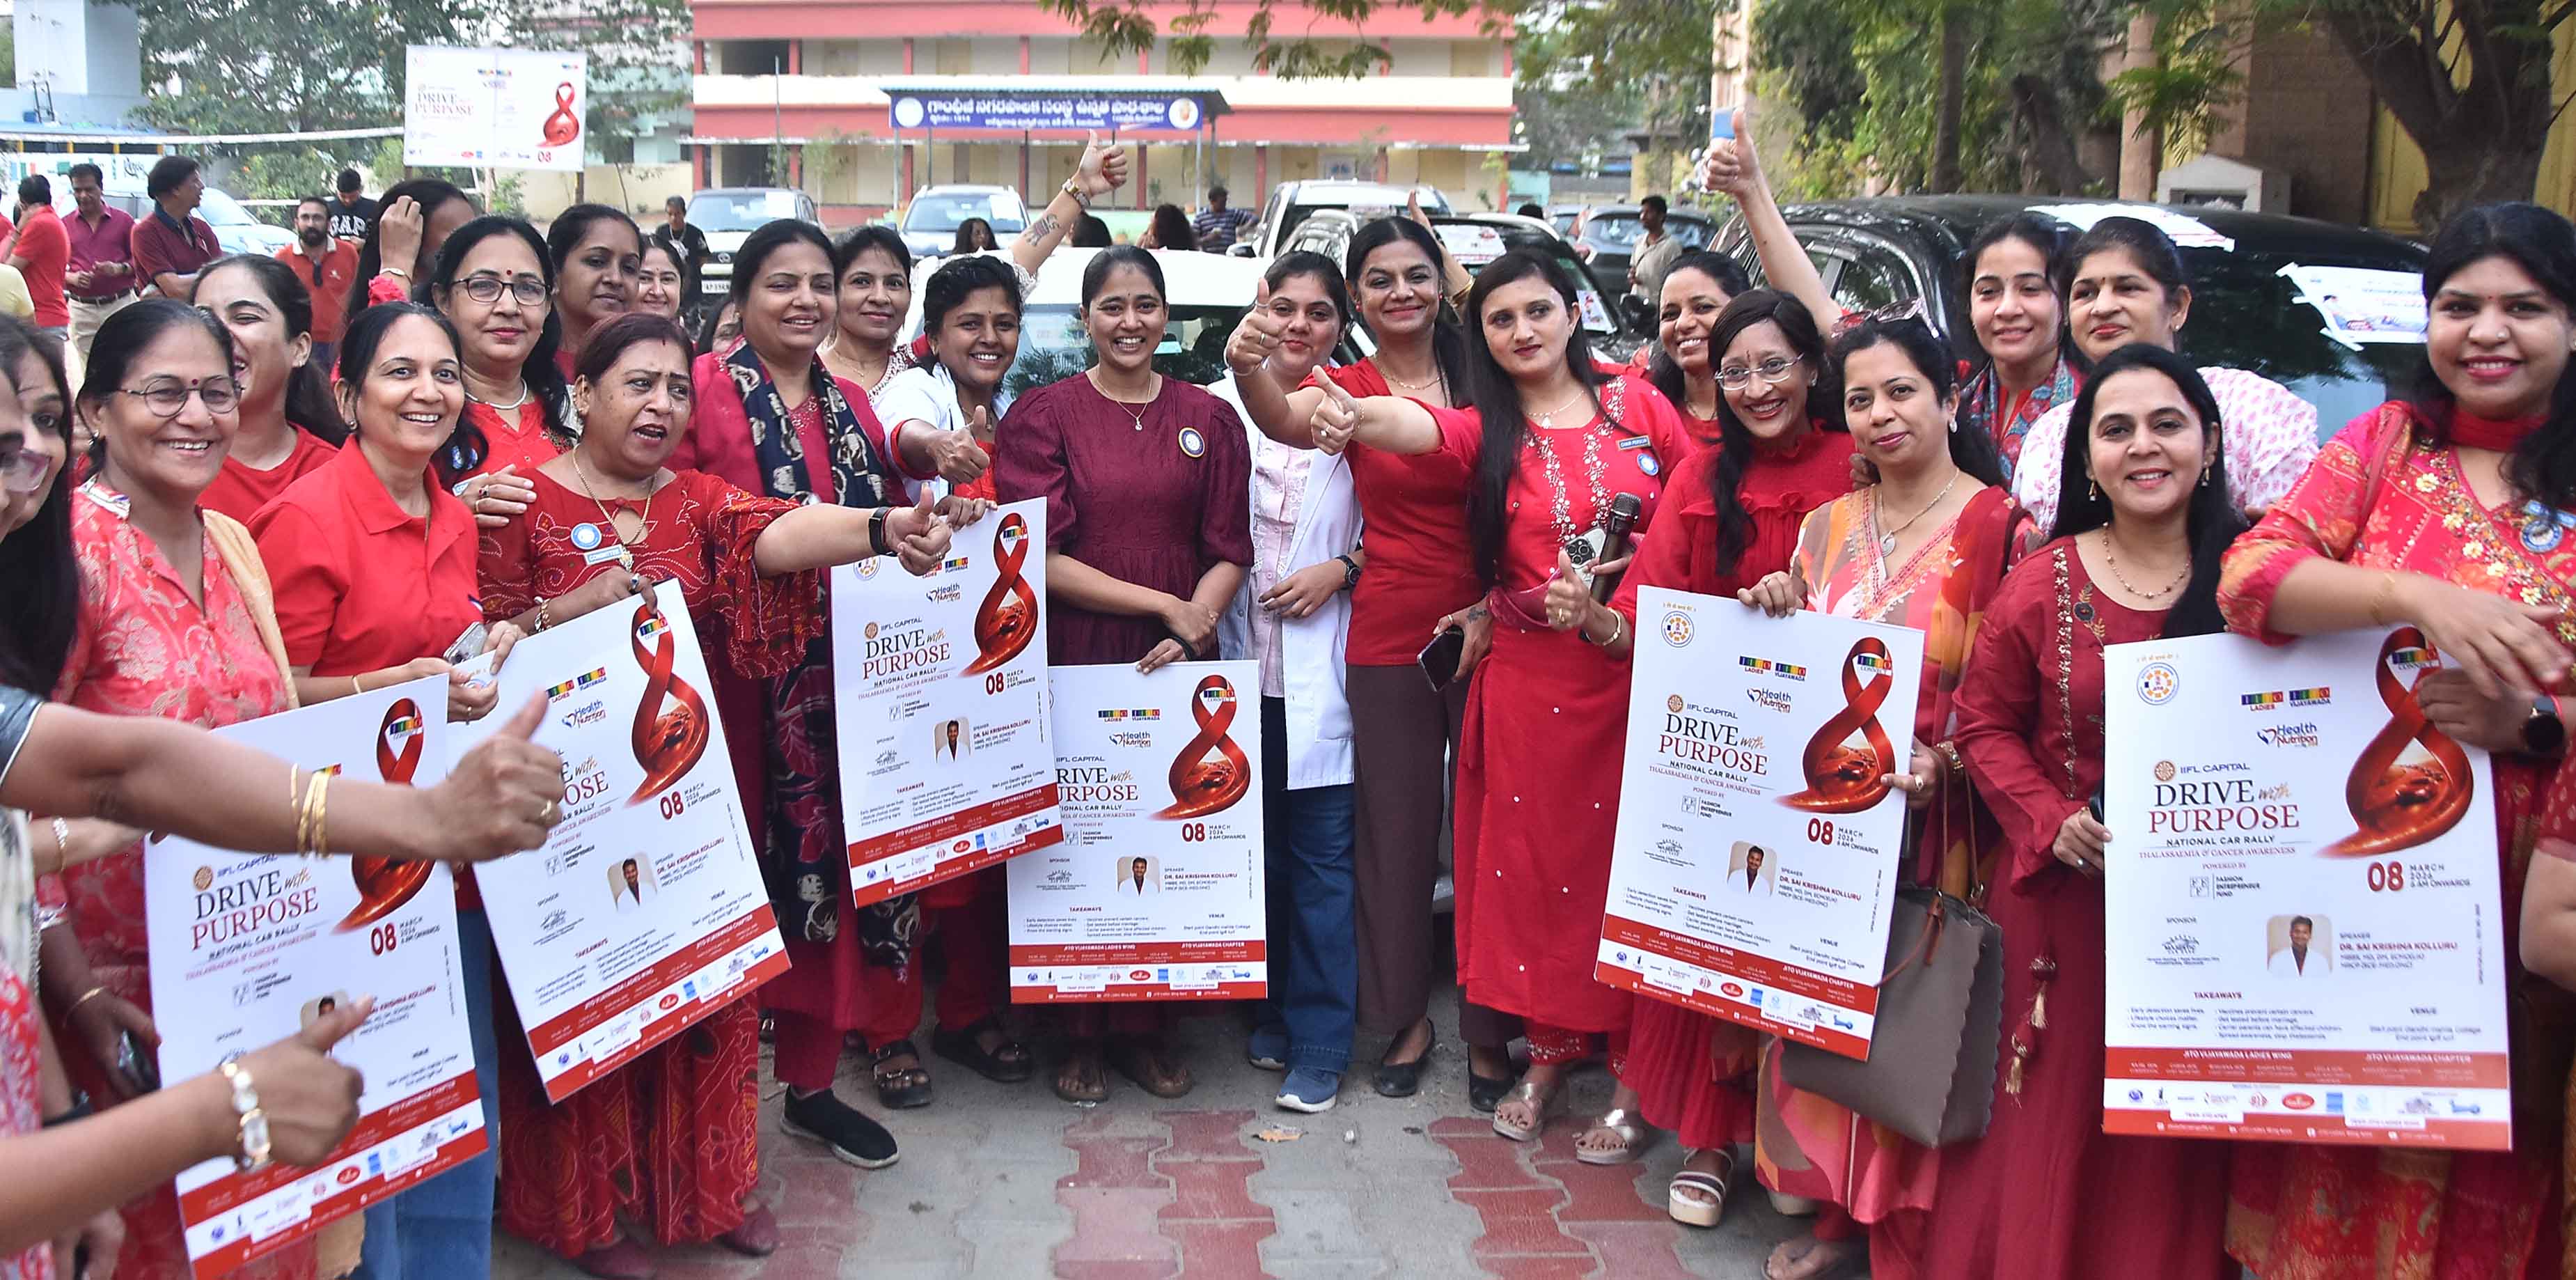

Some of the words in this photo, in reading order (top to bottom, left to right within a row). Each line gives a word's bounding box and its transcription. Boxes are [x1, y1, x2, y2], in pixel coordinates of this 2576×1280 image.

[937, 582, 960, 593] Health
[865, 629, 925, 659] DRIVE
[927, 627, 945, 643] with
[863, 643, 950, 680] PURPOSE
[874, 676, 904, 689] NATIONAL
[905, 671, 918, 680] CAR
[919, 667, 937, 677] RALLY
[1744, 666, 1764, 676] LADIES
[985, 671, 1004, 695] 08
[1007, 669, 1023, 678] MARCH
[1761, 687, 1791, 703] Health
[574, 699, 603, 715] Health
[1687, 703, 1702, 712] IIFL
[1703, 706, 1738, 719] CAPITAL
[1760, 697, 1791, 713] Nutrition
[1123, 731, 1151, 740] Health
[1665, 712, 1739, 747] DRIVE
[1741, 735, 1766, 749] with
[2277, 722, 2317, 737] Health
[2277, 733, 2318, 747] Nutrition
[1658, 734, 1768, 776] PURPOSE
[574, 756, 597, 776] with
[1670, 760, 1706, 774] NATIONAL
[1708, 769, 1723, 778] CAR
[1725, 772, 1748, 783] RALLY
[2203, 763, 2250, 773] CAPITAL
[1055, 767, 1108, 784] RIVE
[1110, 770, 1134, 783] with
[1059, 785, 1138, 802] RPOSE
[1701, 777, 1725, 788] CANCER
[1725, 783, 1761, 795] AWARENESS
[2155, 779, 2254, 807] DRIVE
[2259, 782, 2291, 801] with
[660, 790, 684, 820] 08
[1662, 823, 1683, 832] SPONSOR
[2149, 804, 2300, 834] PURPOSE
[1182, 822, 1205, 842] 08
[1807, 818, 1833, 845] 08
[1839, 827, 1863, 838] MARCH
[2167, 838, 2217, 848] NATIONAL
[2220, 836, 2240, 845] CAR
[2244, 835, 2275, 843] RALLY
[2210, 848, 2245, 857] CANCER
[2245, 845, 2296, 856] AWARENESS
[2367, 861, 2404, 892] 08
[196, 870, 282, 920] DRIVE
[285, 867, 312, 890] with
[1672, 886, 1706, 900] TAKEAWAYS
[1803, 880, 1830, 894] KRISHNA
[1831, 887, 1861, 901] KOLLURU
[191, 887, 319, 951] PURPOSE
[371, 923, 397, 956] 08
[2373, 942, 2413, 951] KRISHNA
[2414, 941, 2458, 951] KOLLURU
[2193, 991, 2243, 1000] TAKEAWAYS
